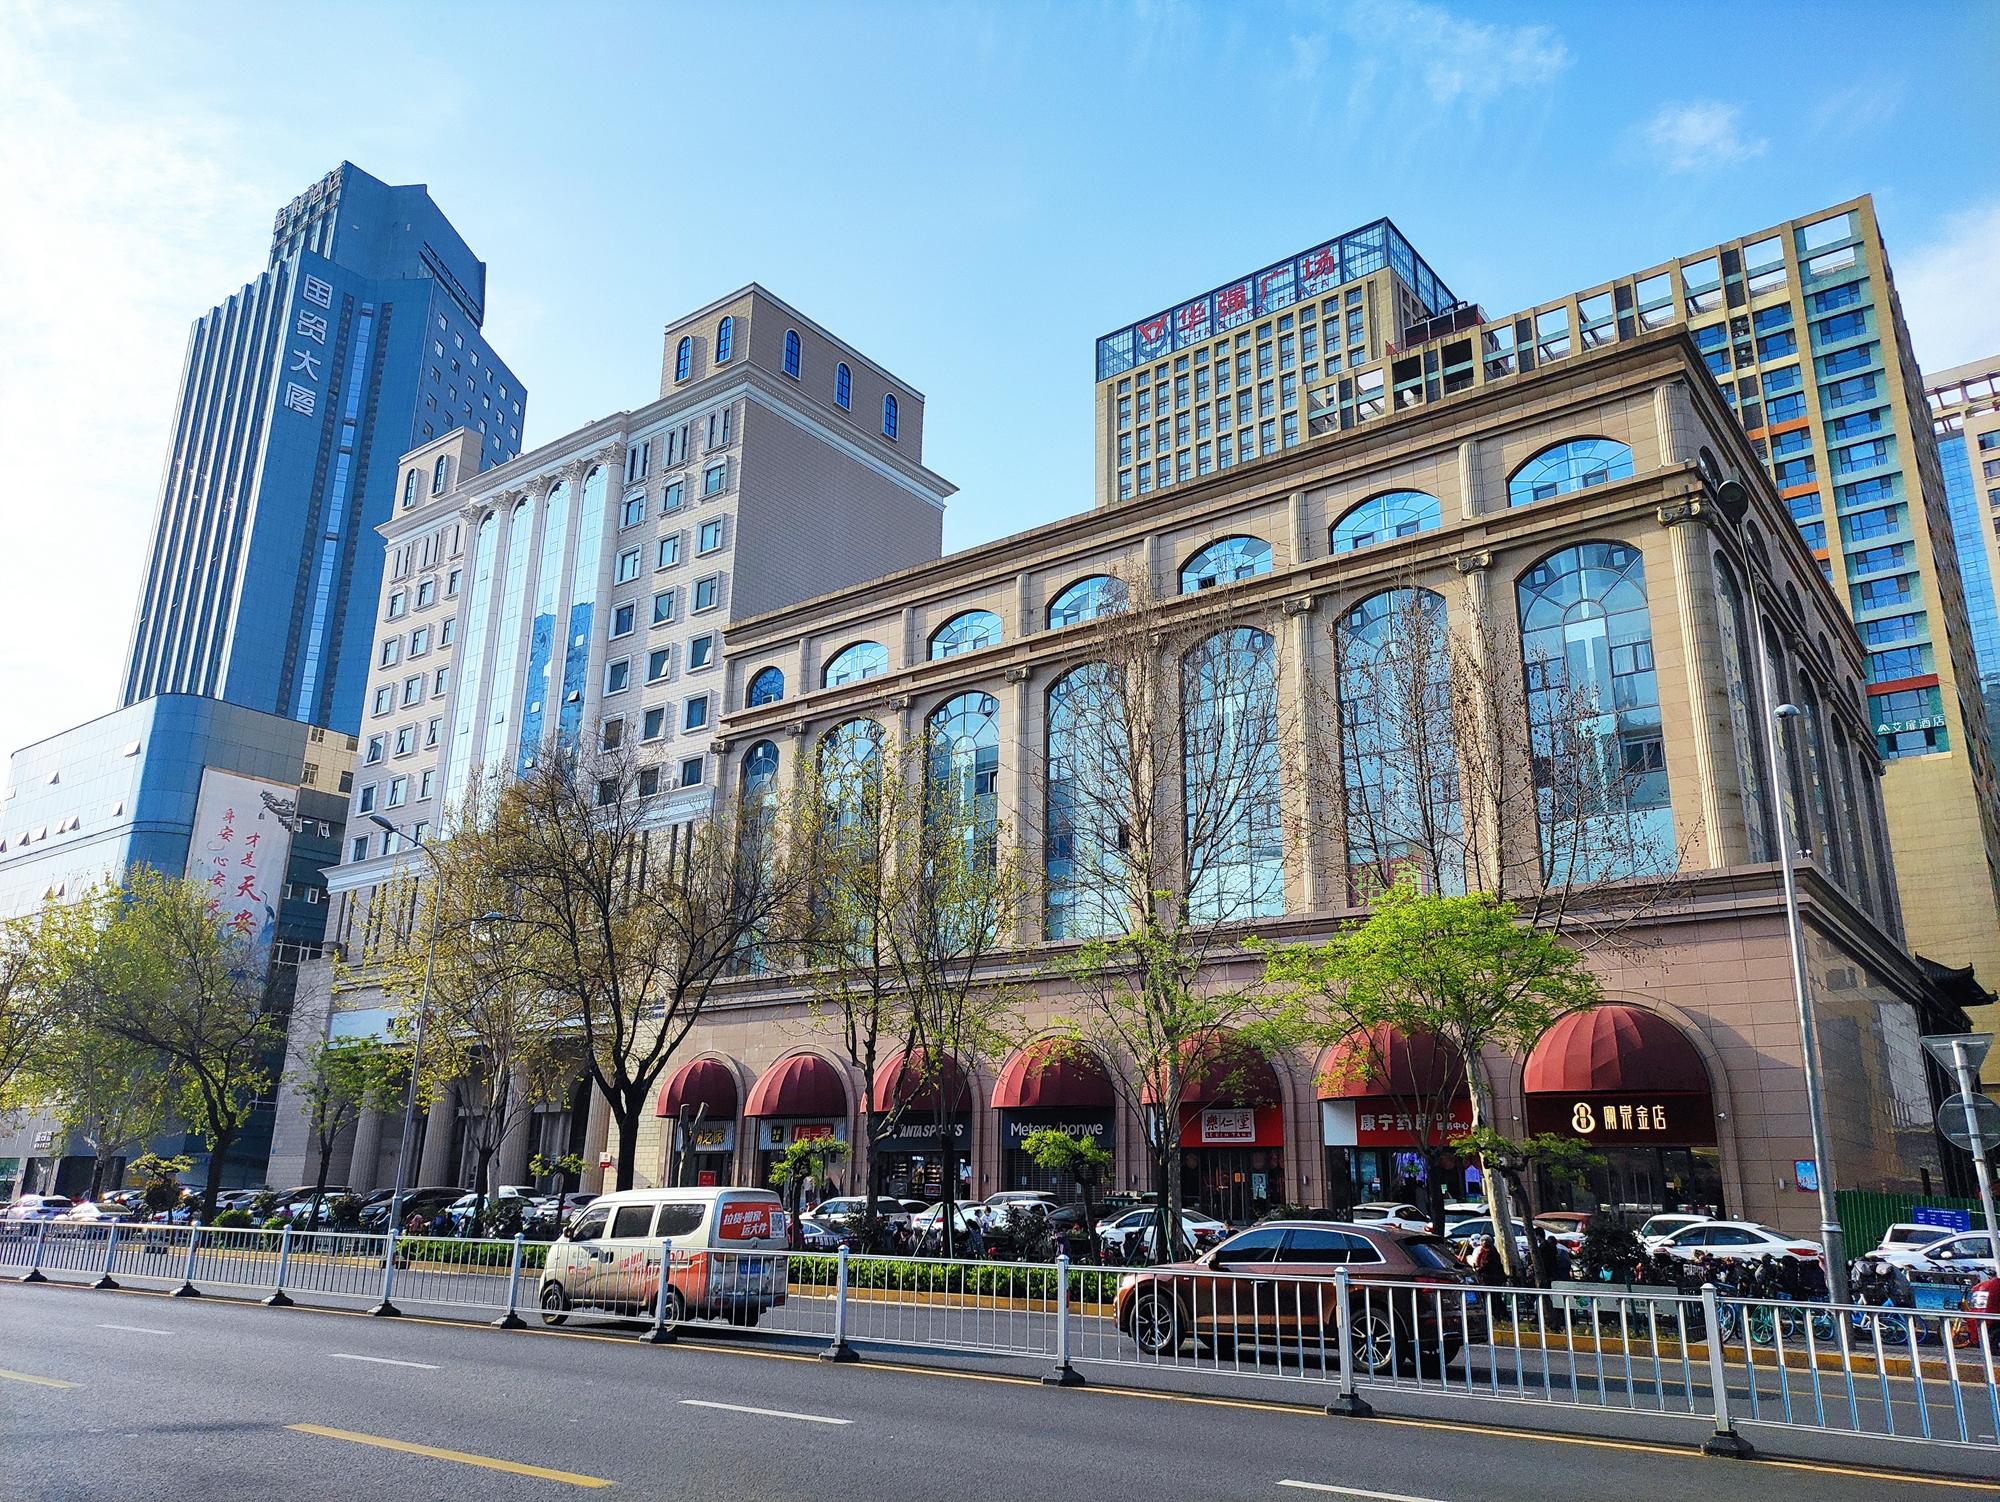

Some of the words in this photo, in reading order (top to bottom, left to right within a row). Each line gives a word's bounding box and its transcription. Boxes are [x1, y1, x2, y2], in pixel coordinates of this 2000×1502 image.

[1177, 247, 1335, 332] 华强广场
[284, 273, 334, 418] 国贸大厦
[1435, 1112, 1456, 1122] DP
